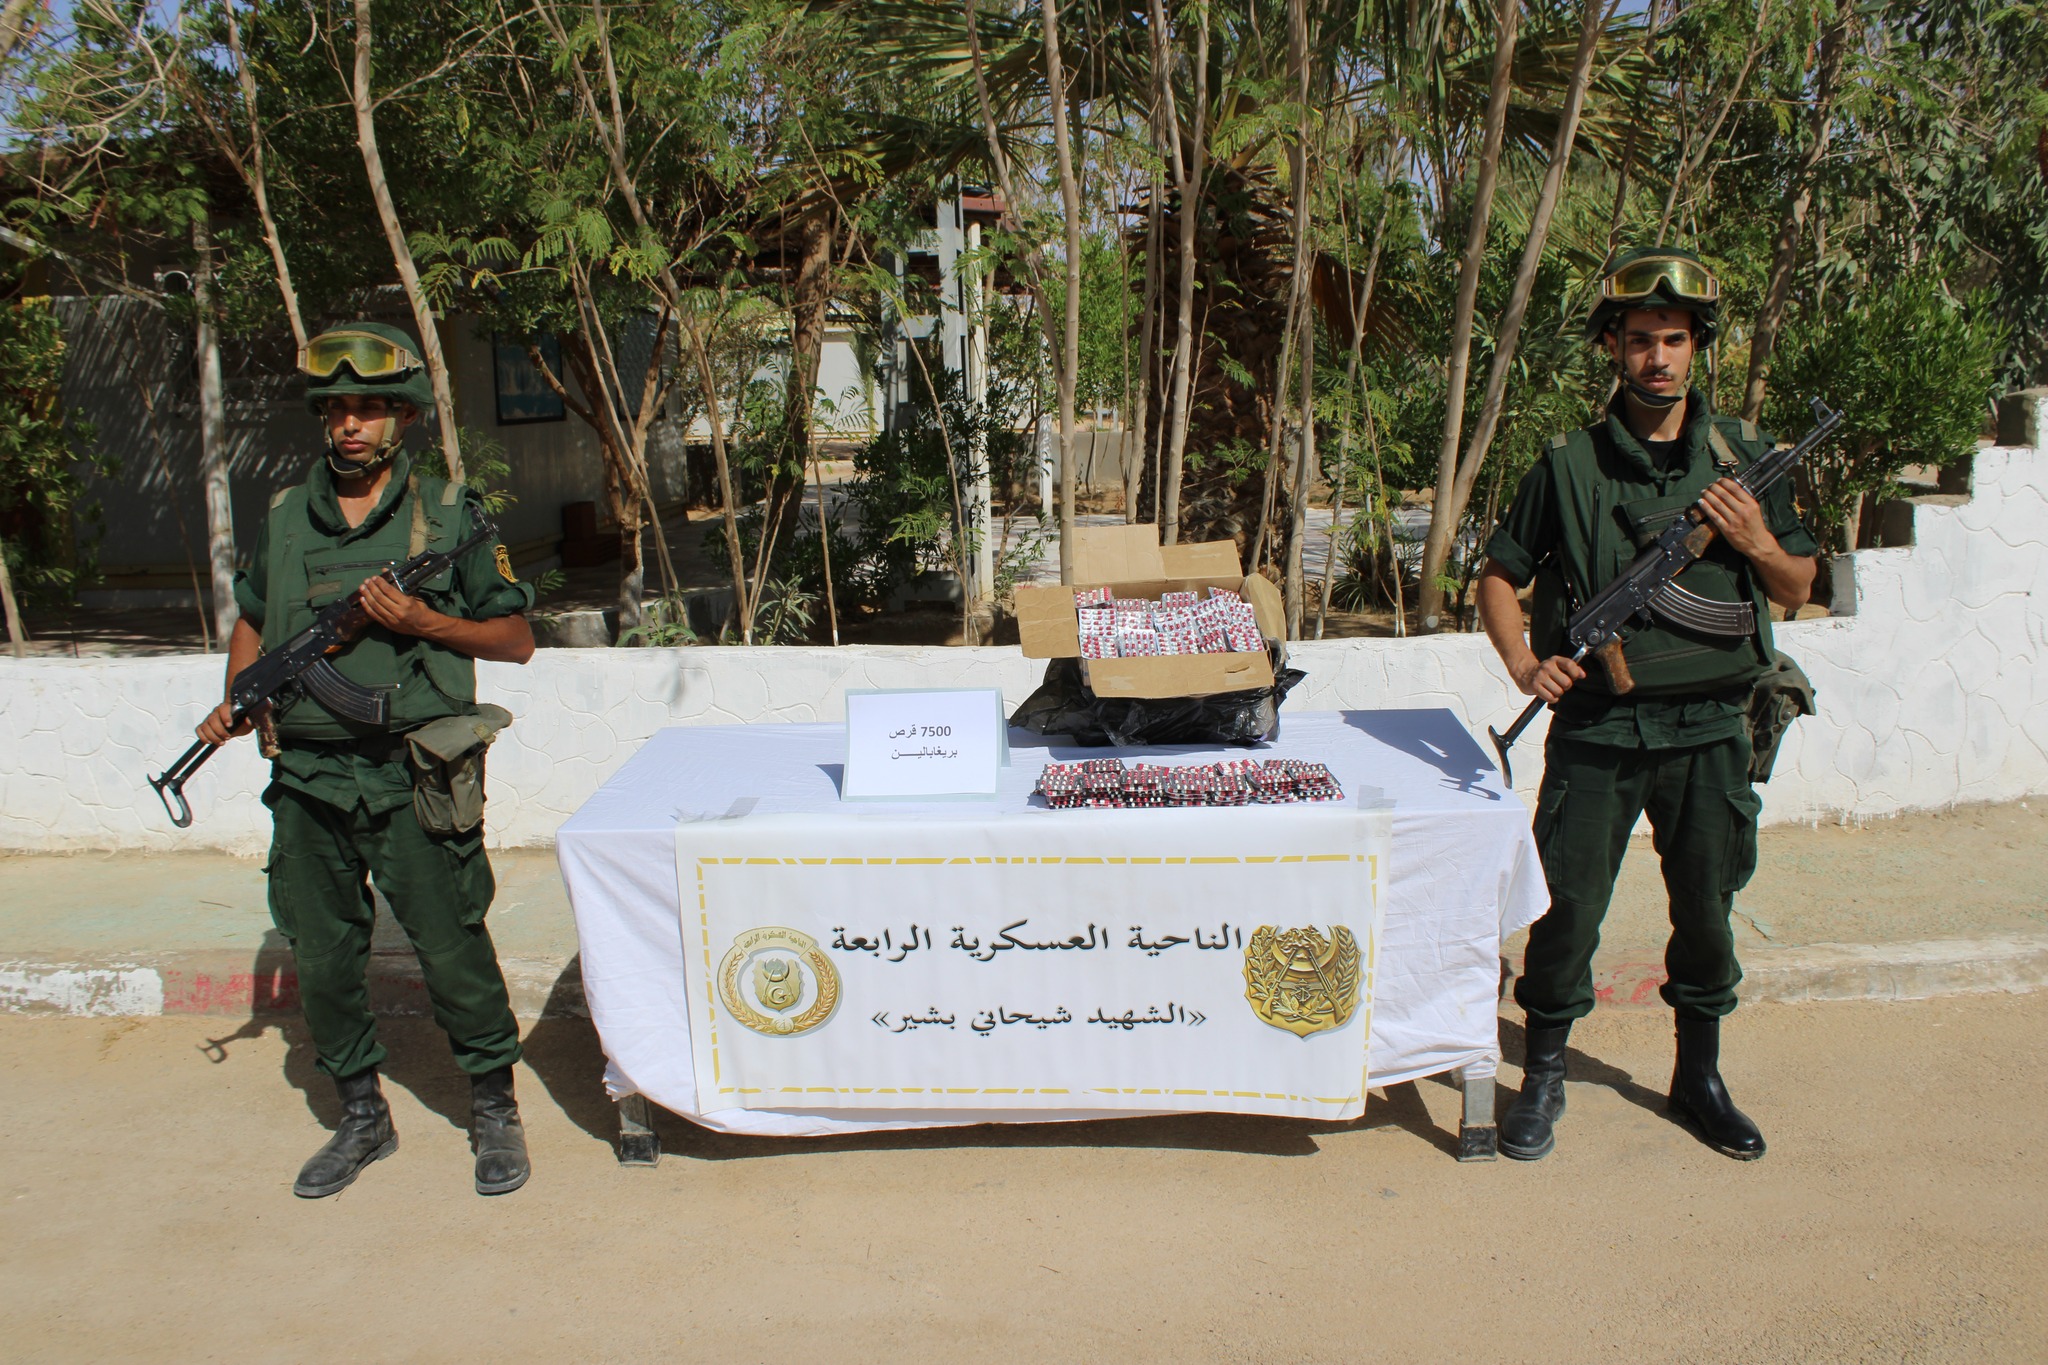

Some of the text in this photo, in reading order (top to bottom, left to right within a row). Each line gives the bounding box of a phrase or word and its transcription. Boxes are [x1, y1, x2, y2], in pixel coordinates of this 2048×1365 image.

[888, 723, 952, 739] 7500 قرص
[831, 919, 1242, 963] الناحية العسكرية الرابعة
[970, 1005, 1073, 1038] شيحاني
